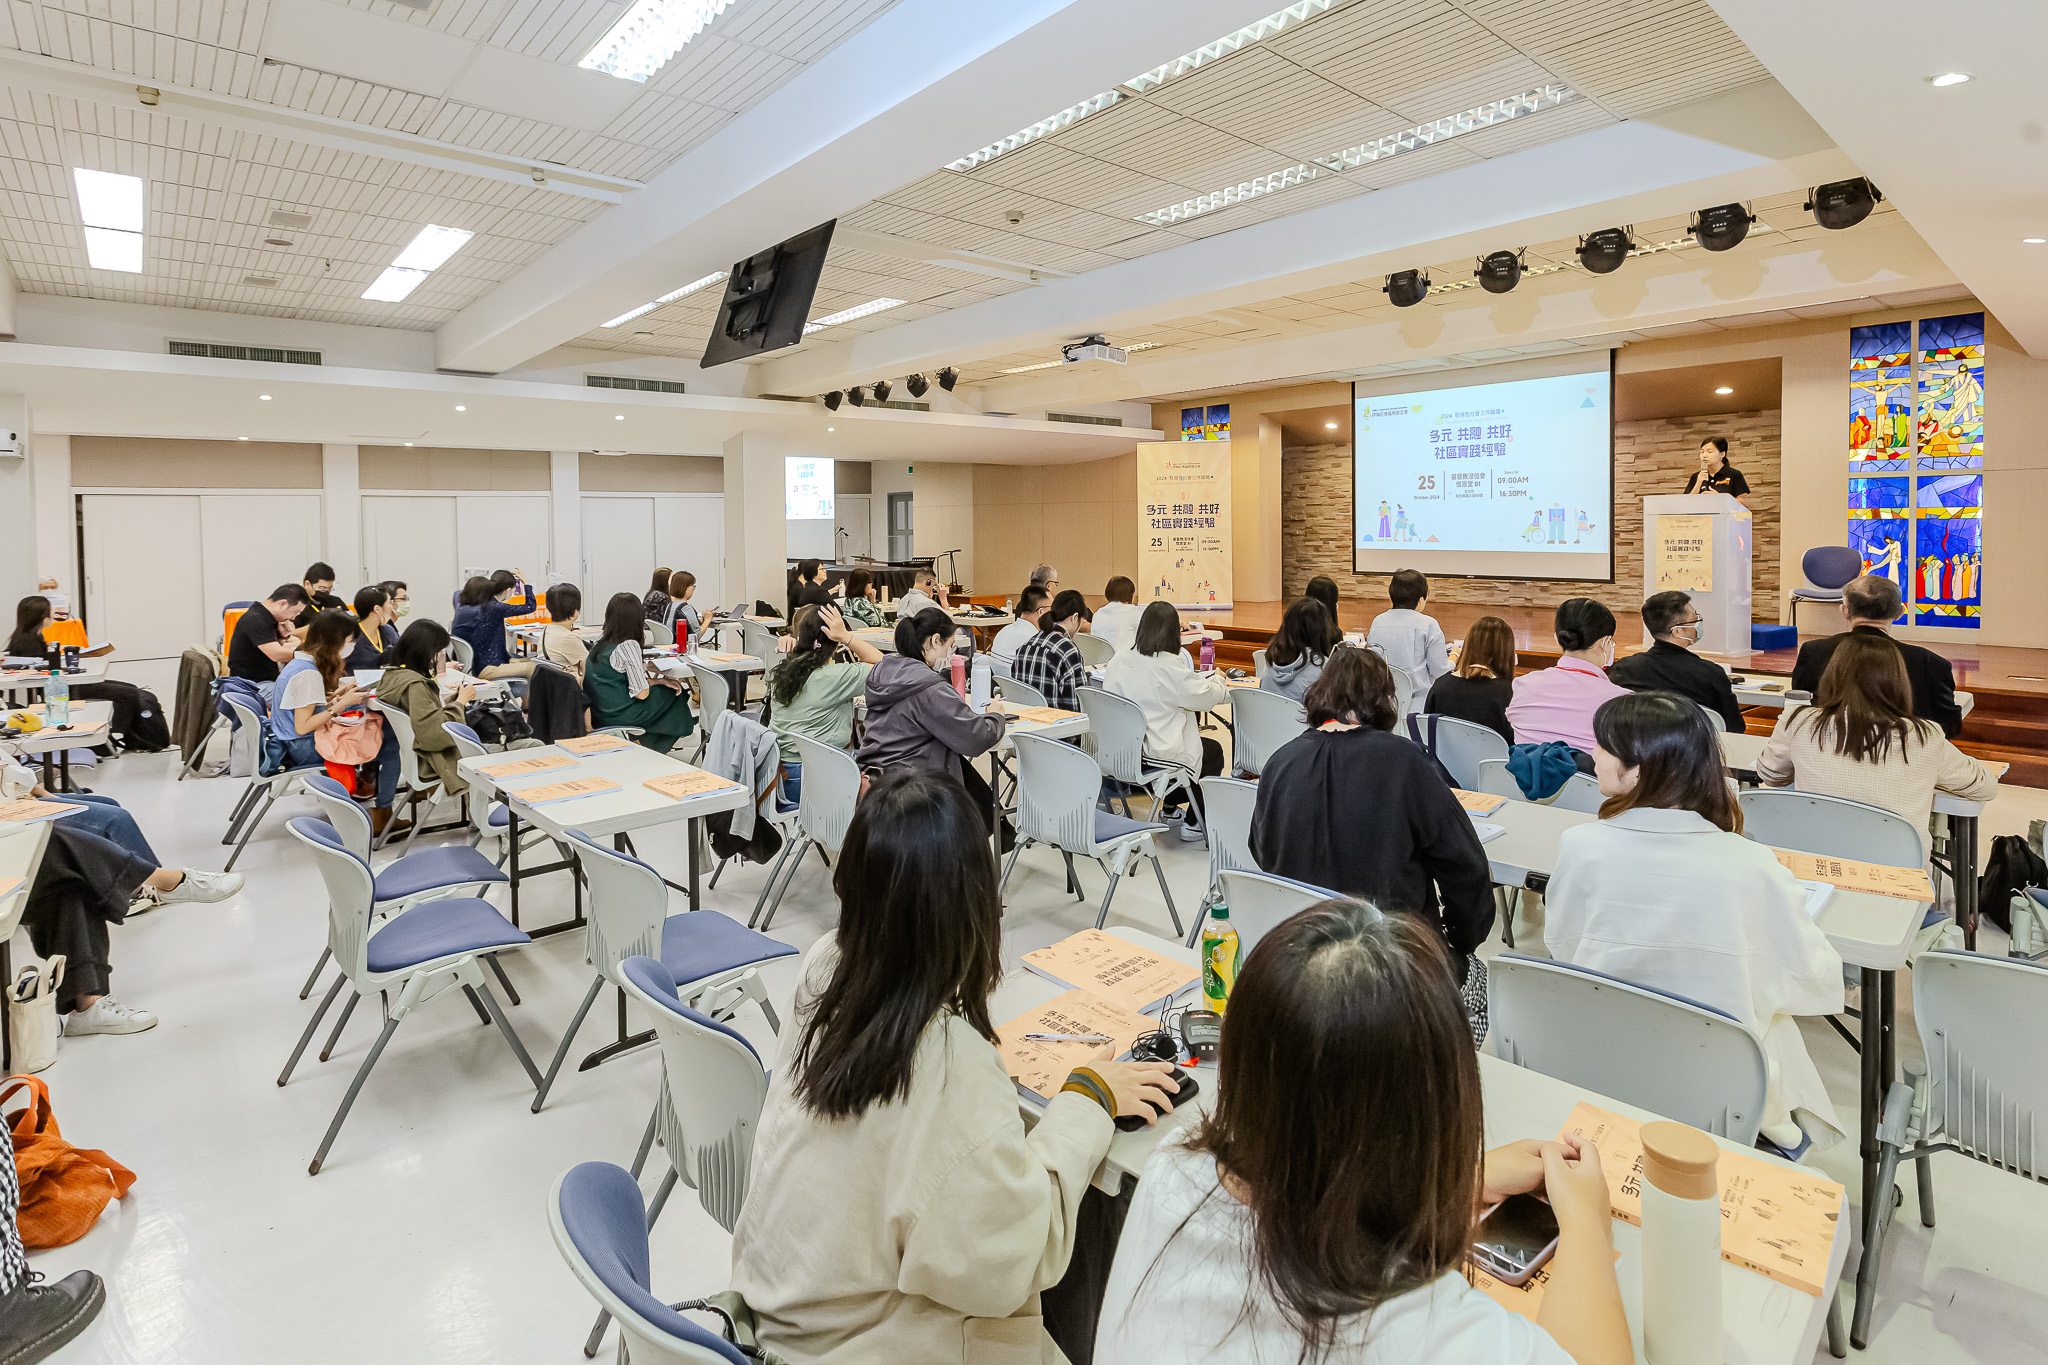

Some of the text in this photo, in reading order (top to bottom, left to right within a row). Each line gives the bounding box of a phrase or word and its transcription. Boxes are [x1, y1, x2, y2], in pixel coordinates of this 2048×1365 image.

[1430, 424, 1512, 443] 多元 共融 共好
[1434, 442, 1506, 460] 社區實踐經驗
[1418, 475, 1436, 490] 25
[1497, 476, 1529, 484] 09:00AM
[1146, 503, 1220, 516] 多元 共融 共好
[1151, 517, 1216, 529] 社區實踐經驗
[1150, 537, 1163, 547] 25
[1044, 1010, 1069, 1022] 多元
